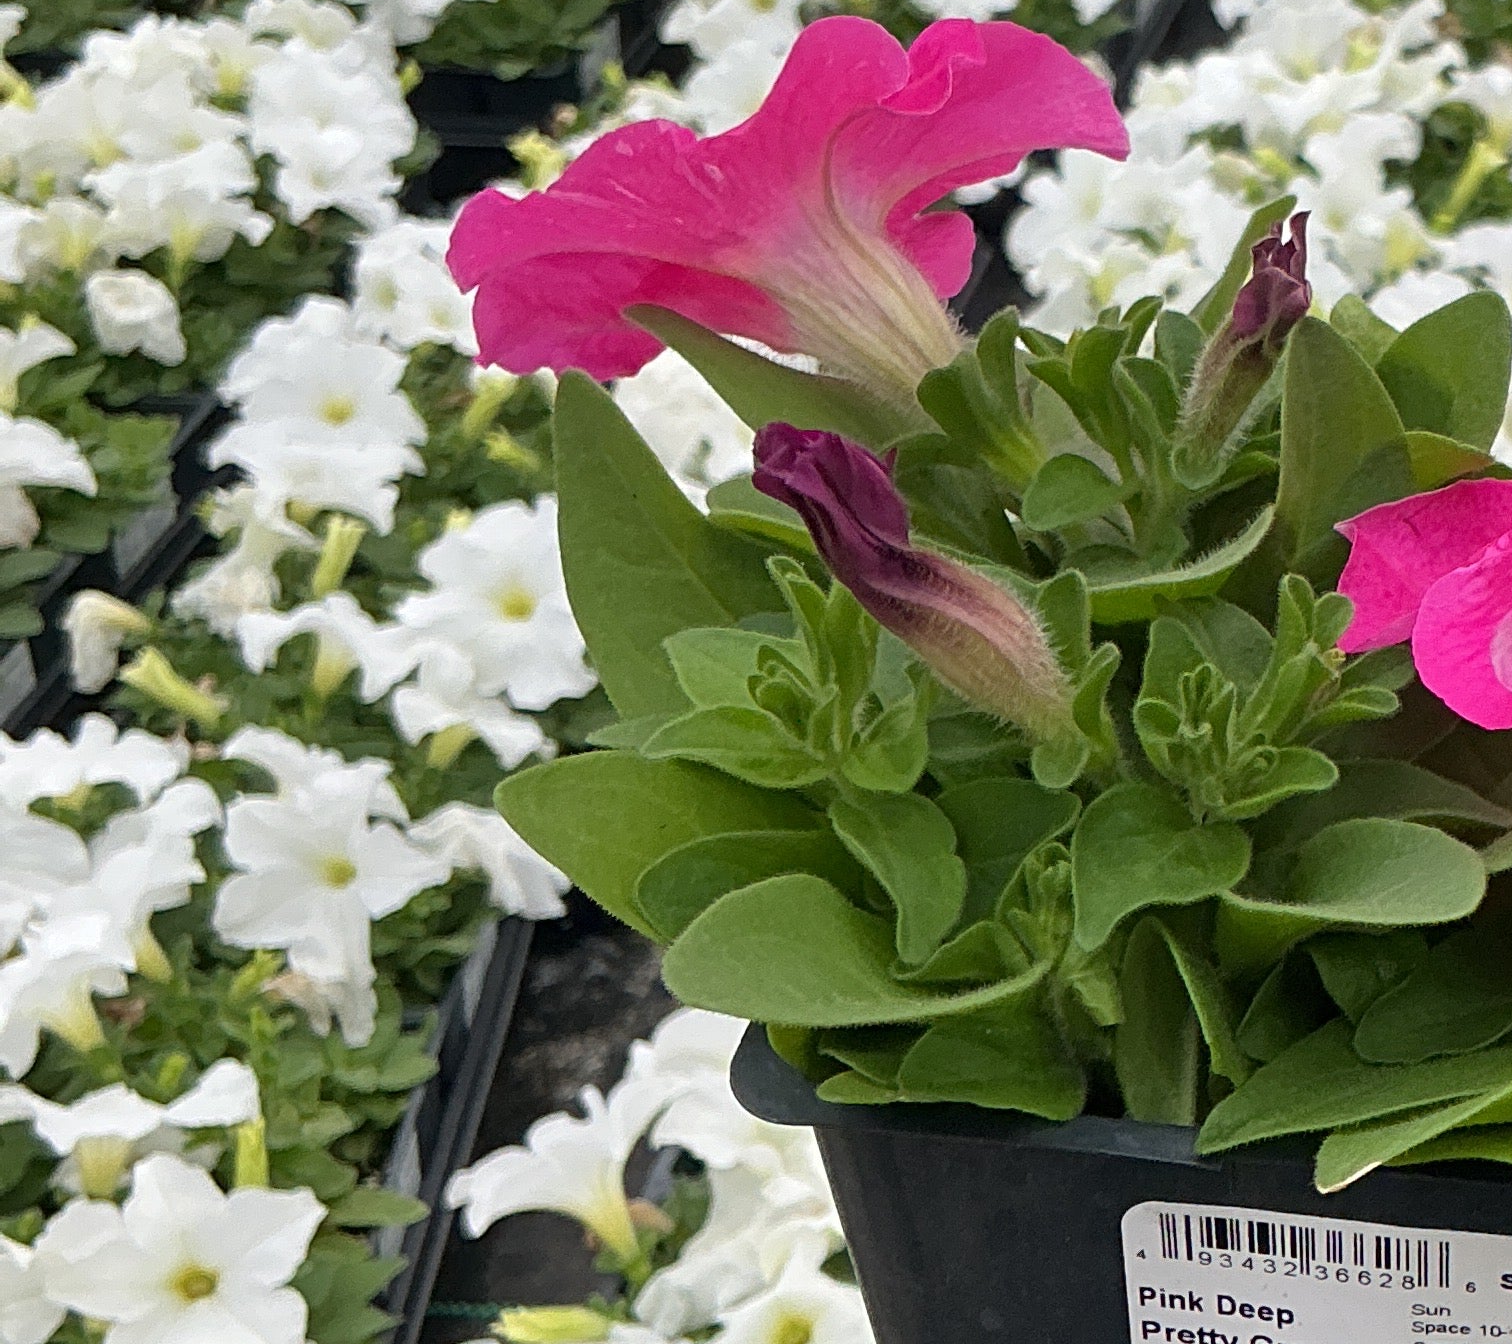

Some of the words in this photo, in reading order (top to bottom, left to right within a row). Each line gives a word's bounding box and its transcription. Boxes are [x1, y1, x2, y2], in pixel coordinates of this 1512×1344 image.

[1136, 1248, 1147, 1260] 4
[1198, 1251, 1298, 1278] 93432
[1315, 1265, 1416, 1290] 36628
[1465, 1281, 1477, 1294] 6
[1138, 1286, 1204, 1312] Pink
[1217, 1294, 1295, 1329] Deep
[1411, 1303, 1451, 1317] Sun
[1411, 1320, 1471, 1335] Space
